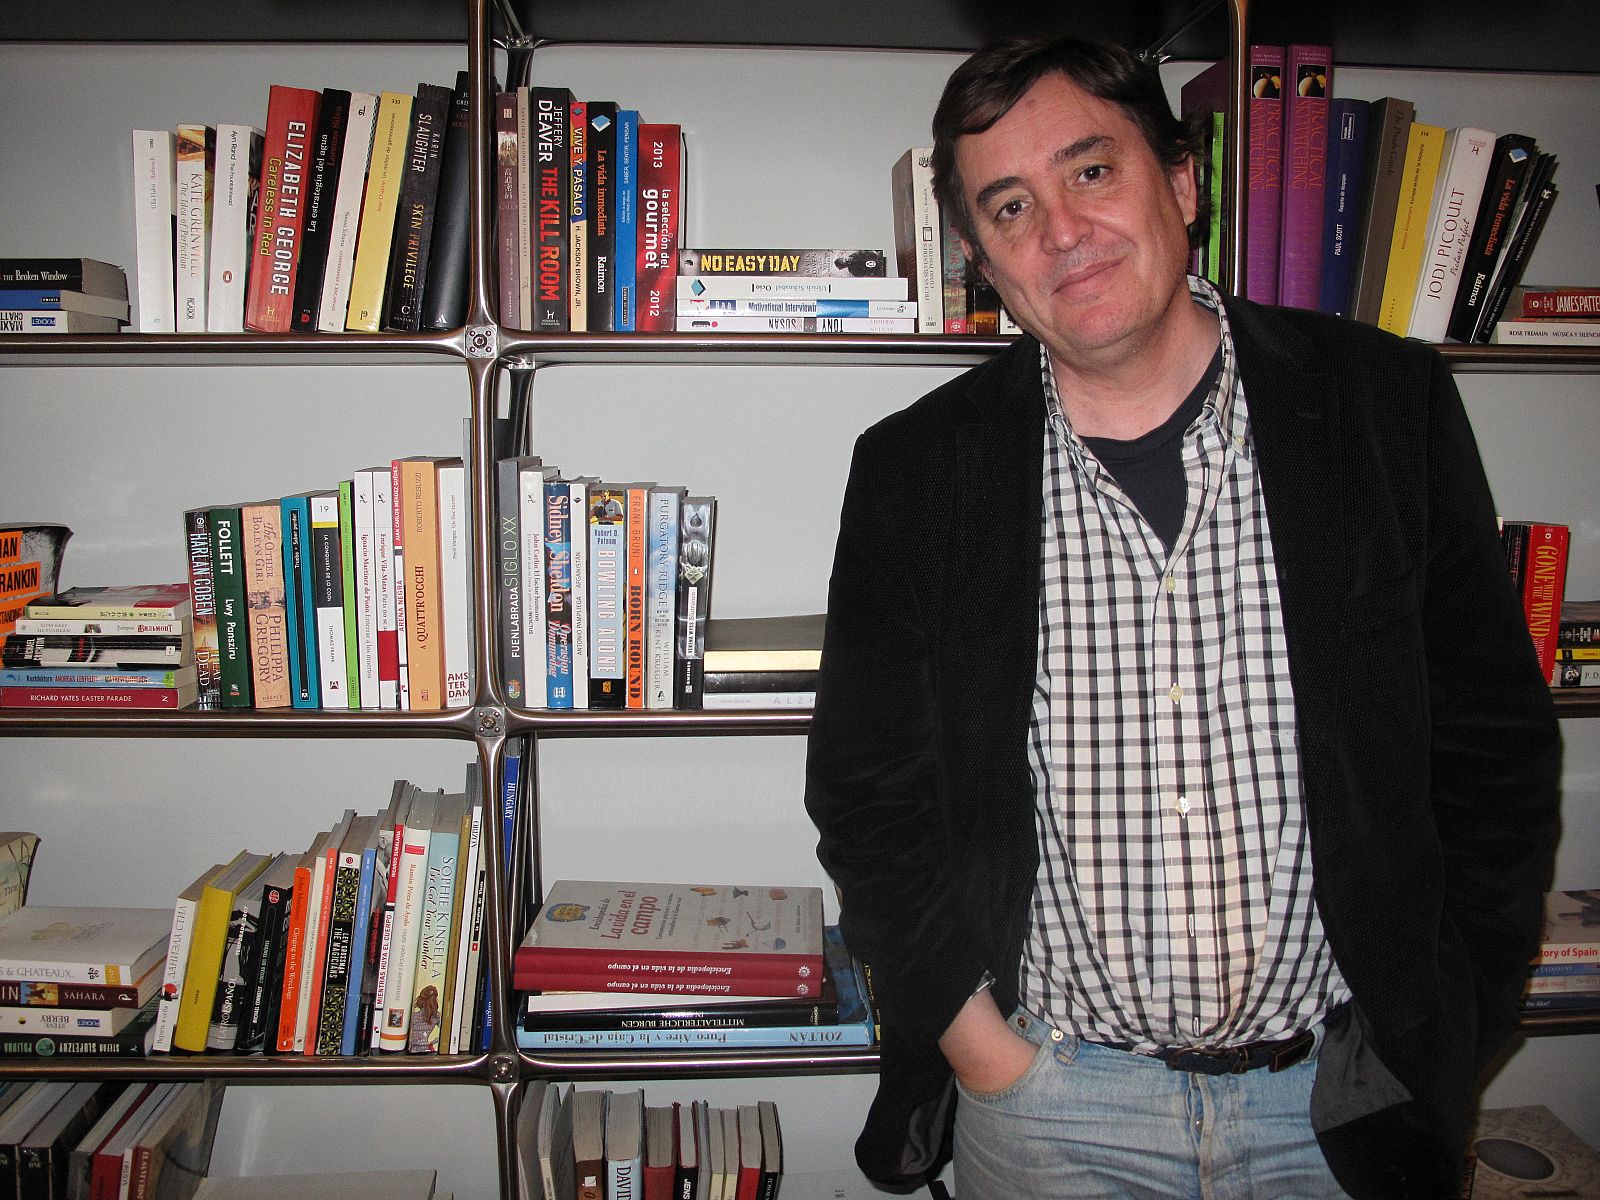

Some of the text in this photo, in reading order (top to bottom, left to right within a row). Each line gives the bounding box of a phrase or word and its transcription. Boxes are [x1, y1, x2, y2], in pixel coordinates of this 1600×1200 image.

[320, 134, 328, 155] agua
[412, 114, 440, 172] KARIN SLAUGHTER
[538, 100, 553, 162] DEAVER
[554, 106, 562, 148] JEFFERY
[653, 142, 664, 168] 2013
[1265, 103, 1280, 190] PRACTICAL
[1309, 101, 1326, 190] PRACTICAL
[278, 120, 306, 218] ELIZABETH
[541, 168, 558, 197] THE
[573, 128, 584, 216] VIVE Y PÁSALO
[260, 158, 282, 256] Careless in Red
[310, 172, 324, 218] estrategia
[598, 150, 608, 237] La vida inmediata
[190, 174, 203, 277] KATE GRENVILLE
[307, 220, 316, 232] La
[540, 200, 560, 242] KILL
[643, 190, 659, 269] gourmet
[660, 189, 671, 269] la selección del
[1484, 179, 1515, 256] La vida inmediata
[270, 226, 296, 296] GEORGE
[404, 203, 425, 290] SKIN PRIVILEGE
[1334, 239, 1342, 256] PAUL
[1427, 188, 1464, 299] JODI PICOULT
[1450, 218, 1470, 276] Picture Perfect
[16, 270, 39, 281] Broken
[40, 271, 68, 280] Window
[540, 246, 560, 301] ROOM
[598, 256, 607, 294] Raimon
[701, 255, 800, 272] NO EASY DAY
[650, 290, 660, 317] 2012
[1468, 273, 1486, 306] Raimon
[1556, 297, 1579, 312] JAMES
[1580, 297, 1600, 312] PATTE
[769, 319, 797, 329] SUSAN
[822, 319, 843, 331] TONY
[597, 537, 617, 545] Putnam
[632, 496, 641, 557] FRANK BRUNI
[658, 499, 670, 568] PURGATORY
[218, 520, 233, 575] FOLLETT
[252, 516, 262, 584] BOLEYN GIRL
[264, 522, 276, 578] The OTHER
[548, 495, 571, 613] Sidney Sheldon
[190, 533, 211, 616] HARLAN COBEN
[503, 516, 520, 658] FUENLABRADA SIGLO XX
[657, 571, 668, 607] RIDGE
[1529, 545, 1559, 637] GONE WITH THE WIND
[223, 598, 236, 660] Lwy Pansziru
[597, 549, 616, 673] BOWLING ALONE
[255, 614, 283, 684] PHILIPPA GREGORY
[630, 585, 641, 699] BORN ROUND
[196, 651, 221, 686] PLAY DEAD
[448, 673, 469, 682] AMS
[505, 782, 516, 819] HUNGARY
[408, 864, 416, 885] Ramón
[406, 886, 414, 901] Pérez
[620, 899, 634, 908] en
[383, 914, 392, 941] CUERPO
[403, 911, 411, 926] Ayala
[421, 867, 440, 970] I've Got Your Number
[432, 857, 455, 978] SOPHIE KINSELLA
[601, 928, 623, 939] La
[608, 910, 628, 927] vida
[630, 896, 661, 935] campo
[168, 905, 187, 978] ДАНИЭЛА СТИЛ
[290, 928, 300, 952] Clinging
[330, 927, 342, 978] THE MAGICIANS
[338, 932, 349, 974] LEV GROSSMAN
[1541, 950, 1558, 958] tory
[1573, 948, 1597, 958] Spain
[379, 953, 388, 970] HUYA
[608, 964, 630, 972] campo
[668, 965, 675, 973] la
[687, 966, 731, 974] Enciclopedia
[64, 991, 105, 1000] SAHARA
[286, 972, 296, 1000] Wreckage
[376, 971, 386, 1004] MIENTRAS
[686, 983, 731, 992] Enciclopedia
[544, 1033, 583, 1042] Cristal
[589, 1033, 603, 1041] de
[608, 1032, 633, 1041] Caja
[660, 1019, 744, 1027] MITTELALTERLICHE
[666, 1032, 691, 1040] Aire
[697, 1033, 727, 1041] Puro
[790, 1032, 842, 1045] ZOLTÁN
[682, 1178, 691, 1200] JENS
